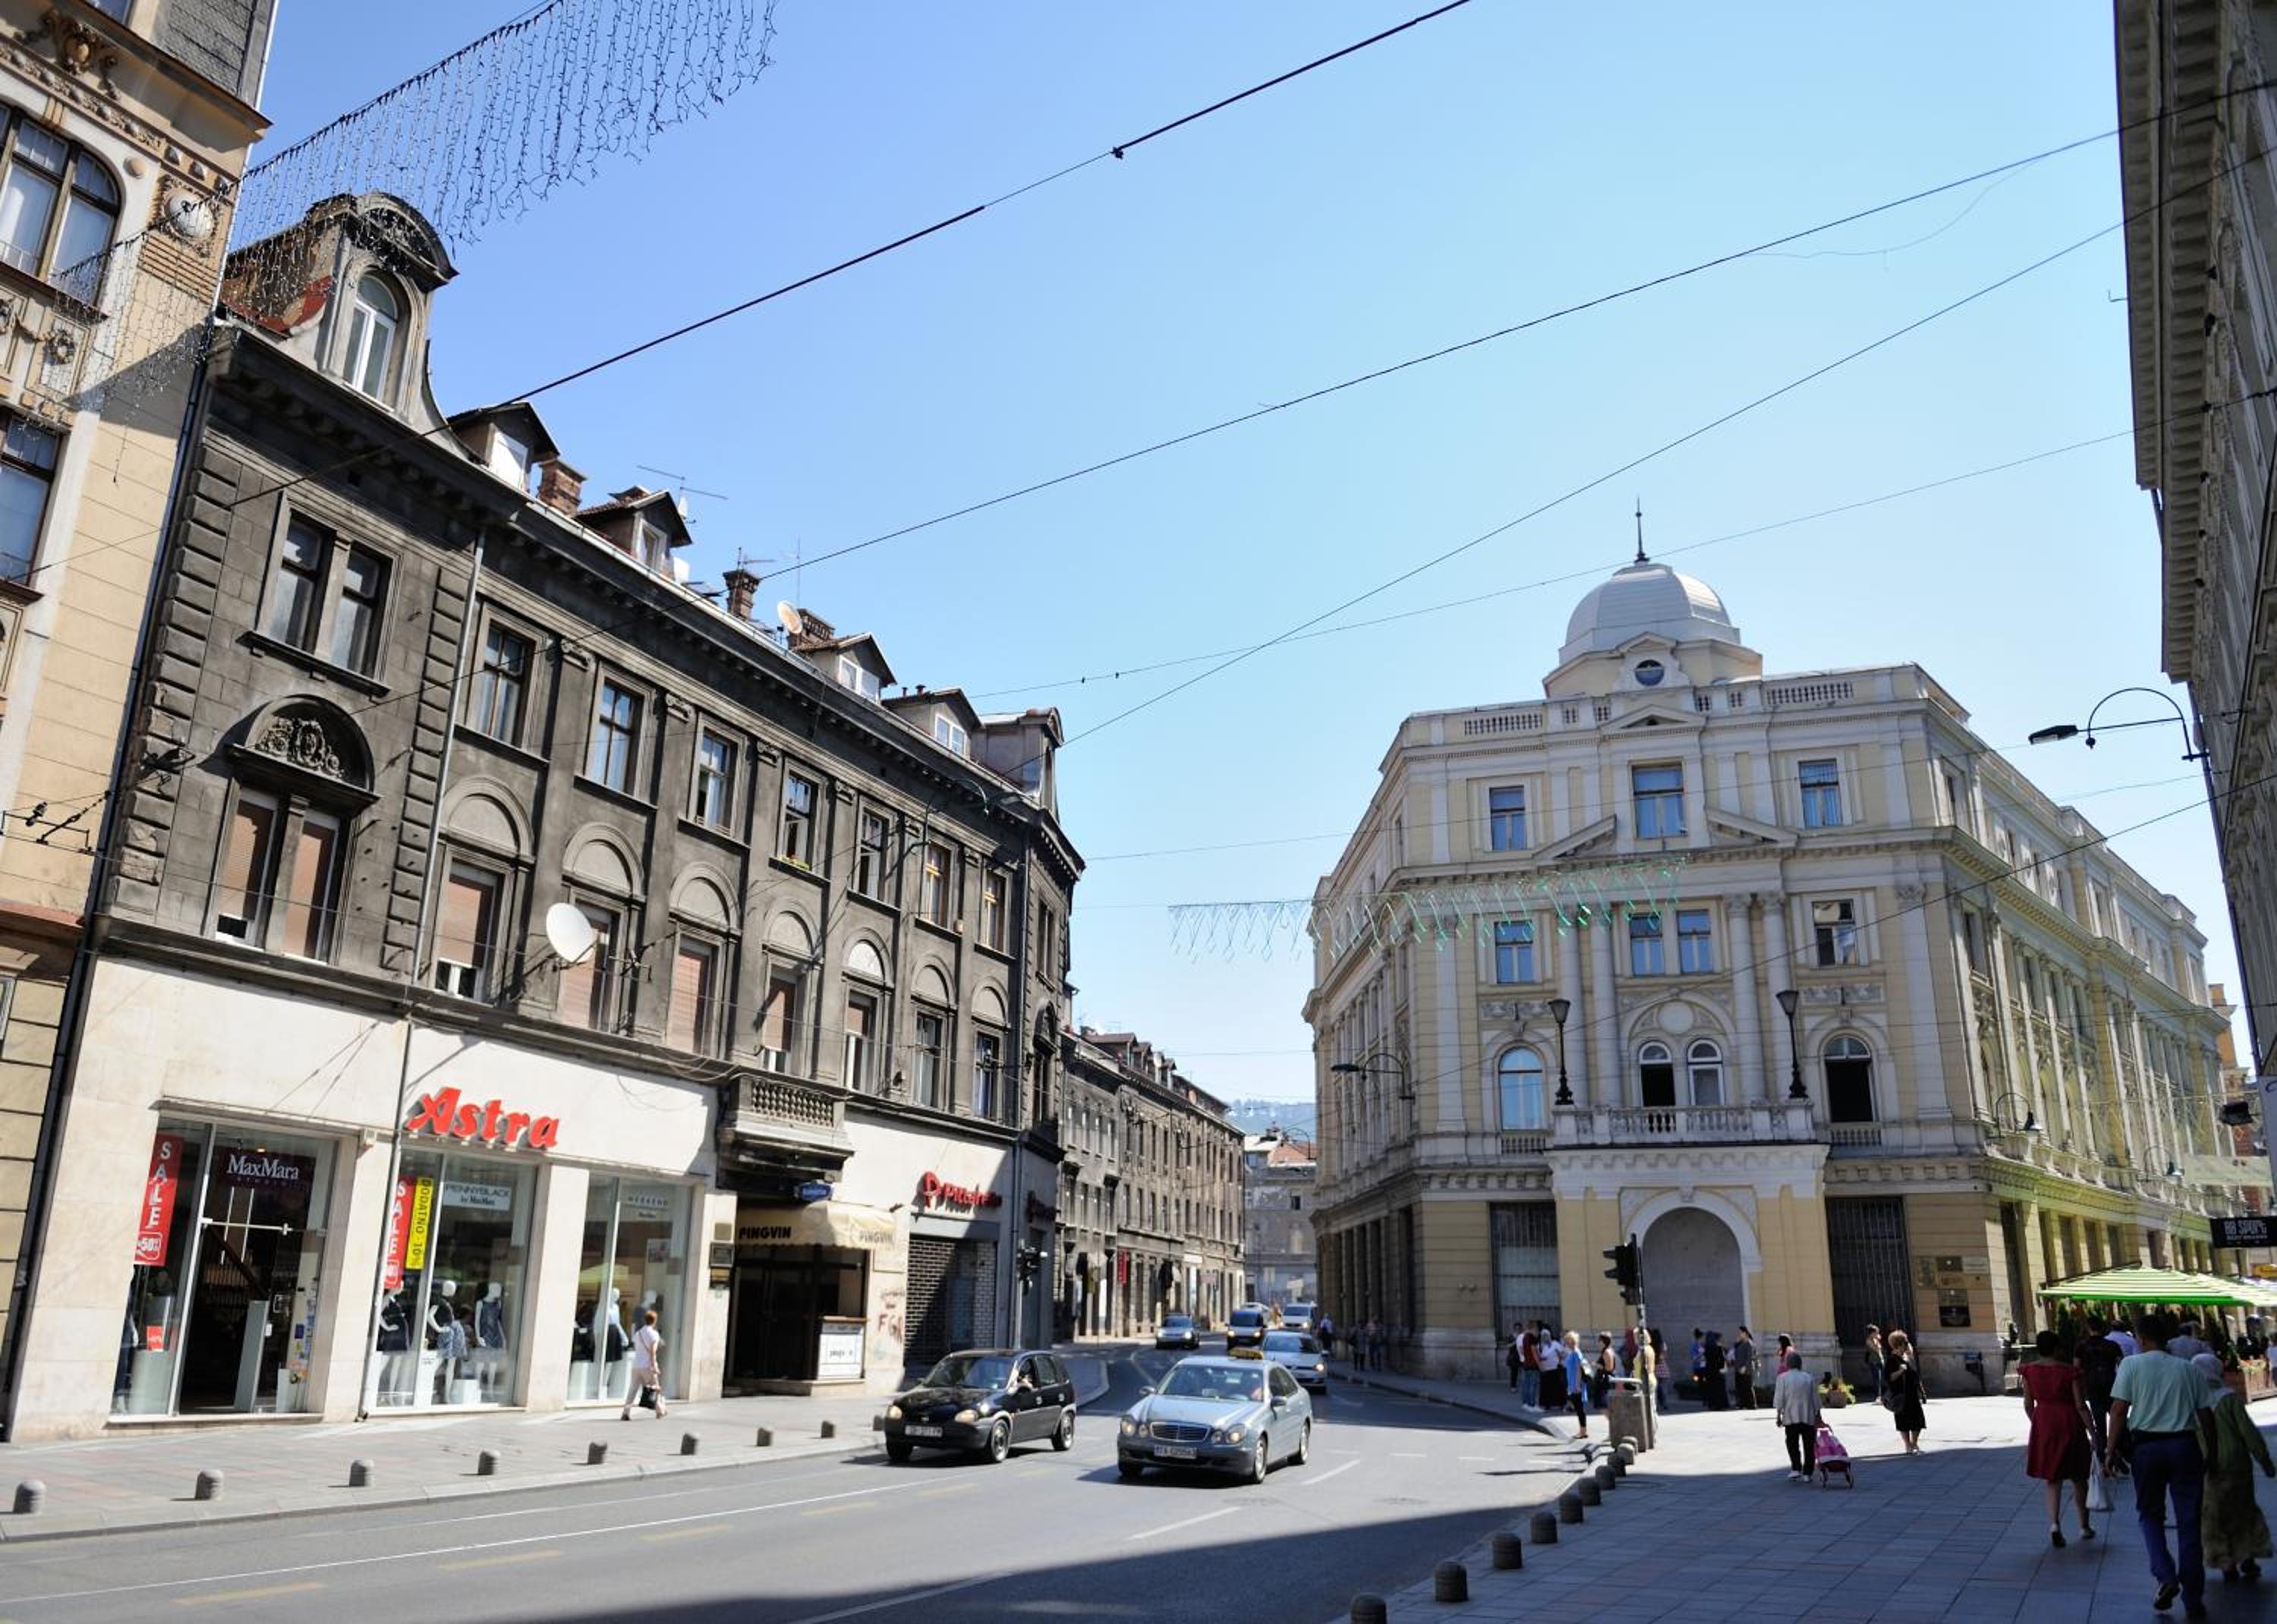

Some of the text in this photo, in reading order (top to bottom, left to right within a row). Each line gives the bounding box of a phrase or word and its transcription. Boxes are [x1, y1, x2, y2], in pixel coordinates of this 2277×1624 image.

[406, 1087, 559, 1148] Astra
[146, 1141, 172, 1229] SALE
[227, 1153, 299, 1179] MaxMara
[389, 1181, 407, 1254] SALE
[739, 1226, 792, 1239] PINGVIN
